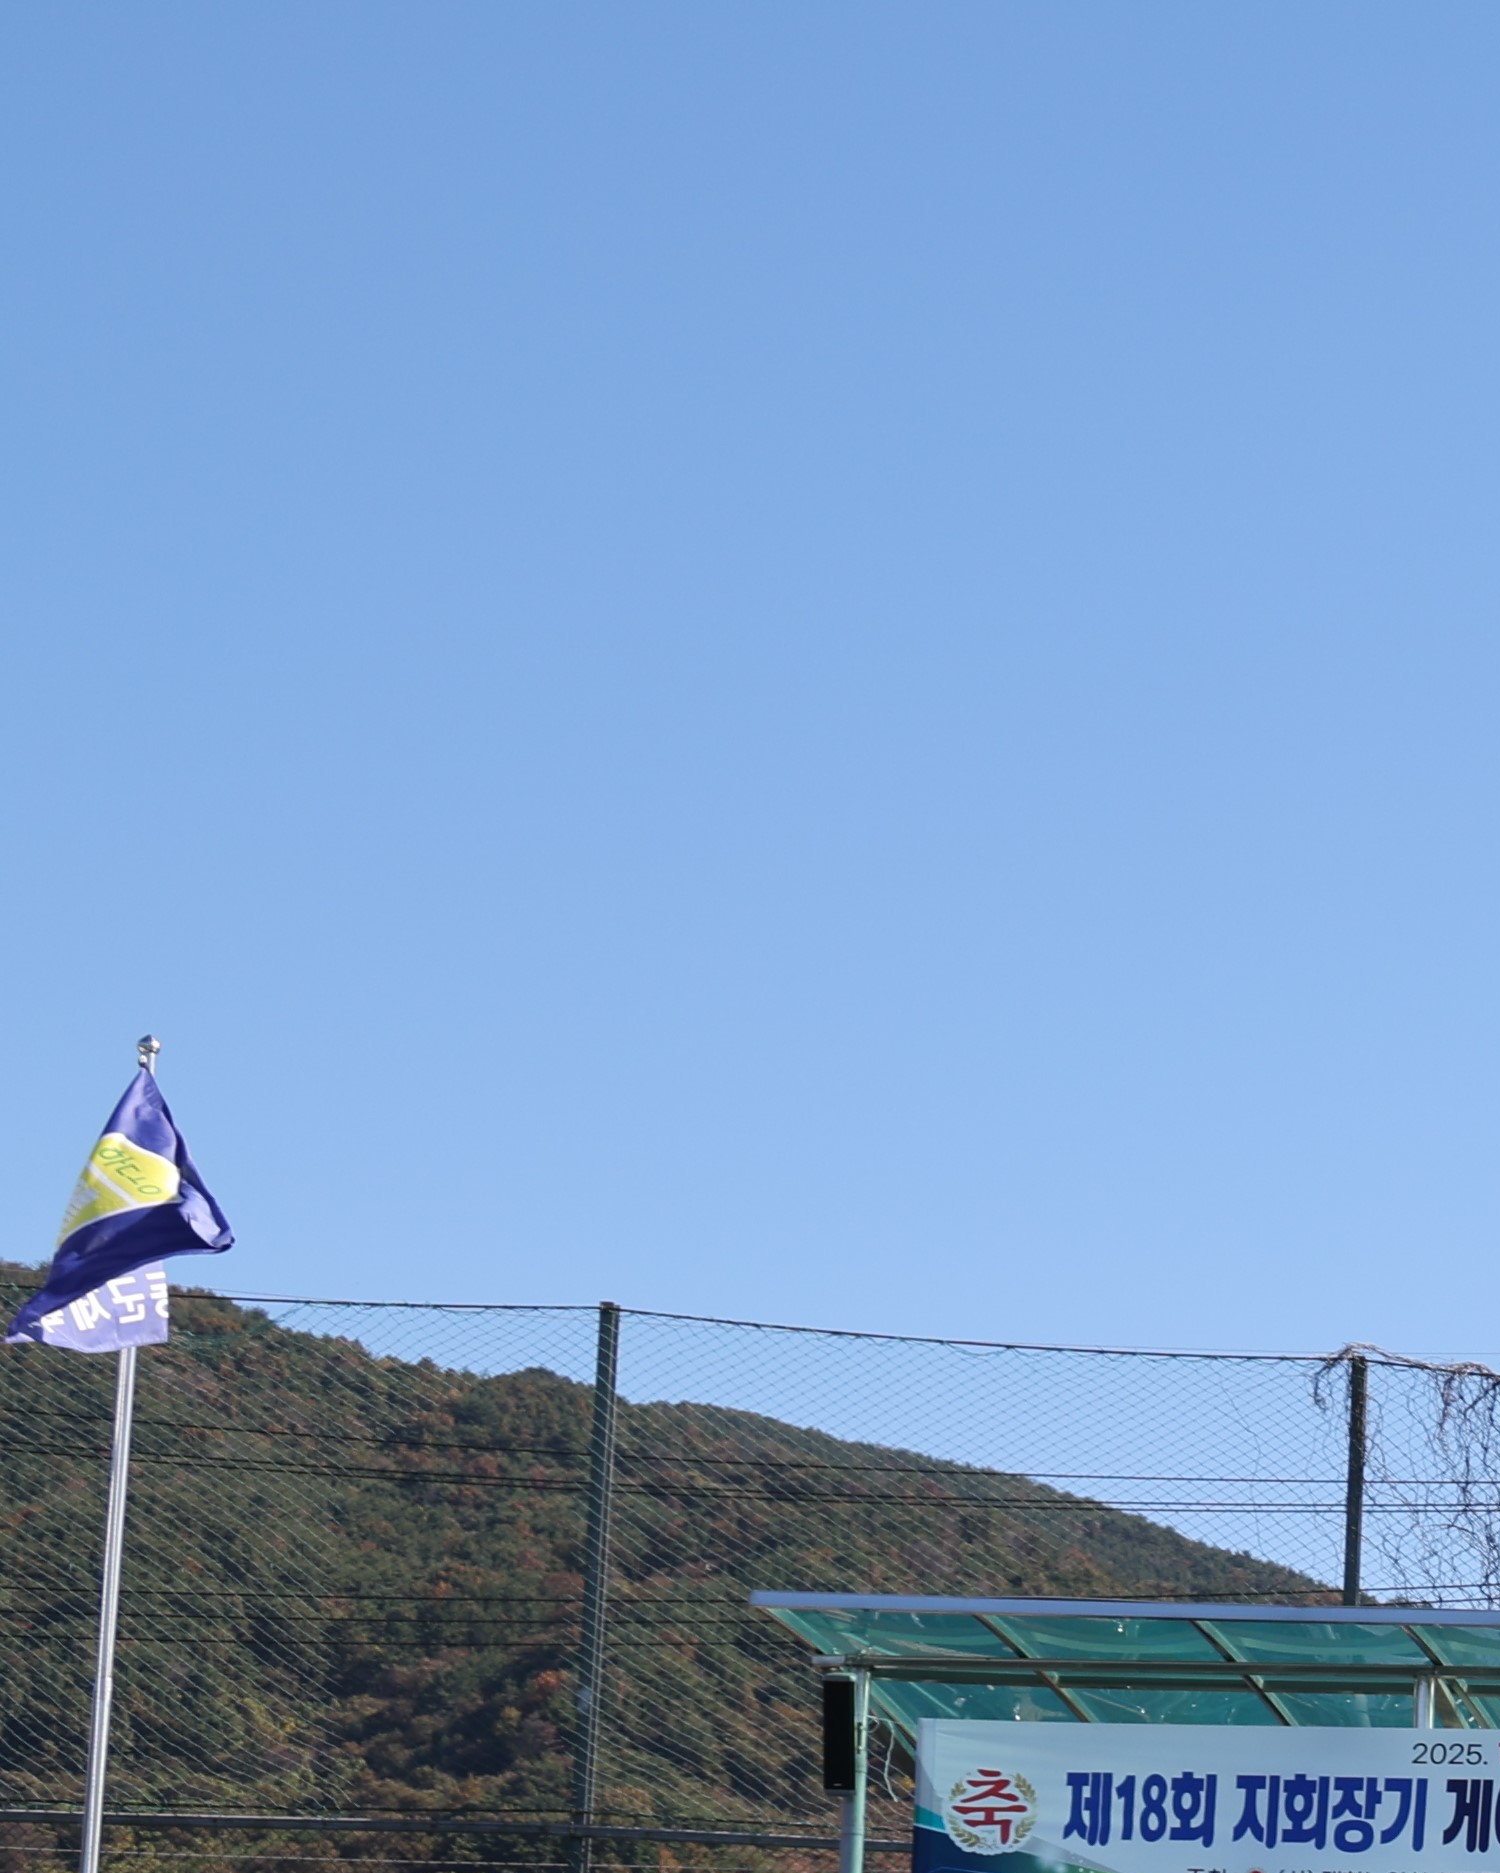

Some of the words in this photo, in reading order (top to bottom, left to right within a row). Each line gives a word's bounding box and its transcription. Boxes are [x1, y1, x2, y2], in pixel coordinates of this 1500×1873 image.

[1411, 1742, 1488, 1766] 2025.
[1062, 1770, 1215, 1849] 제18회
[1231, 1773, 1429, 1854] 지회장기
